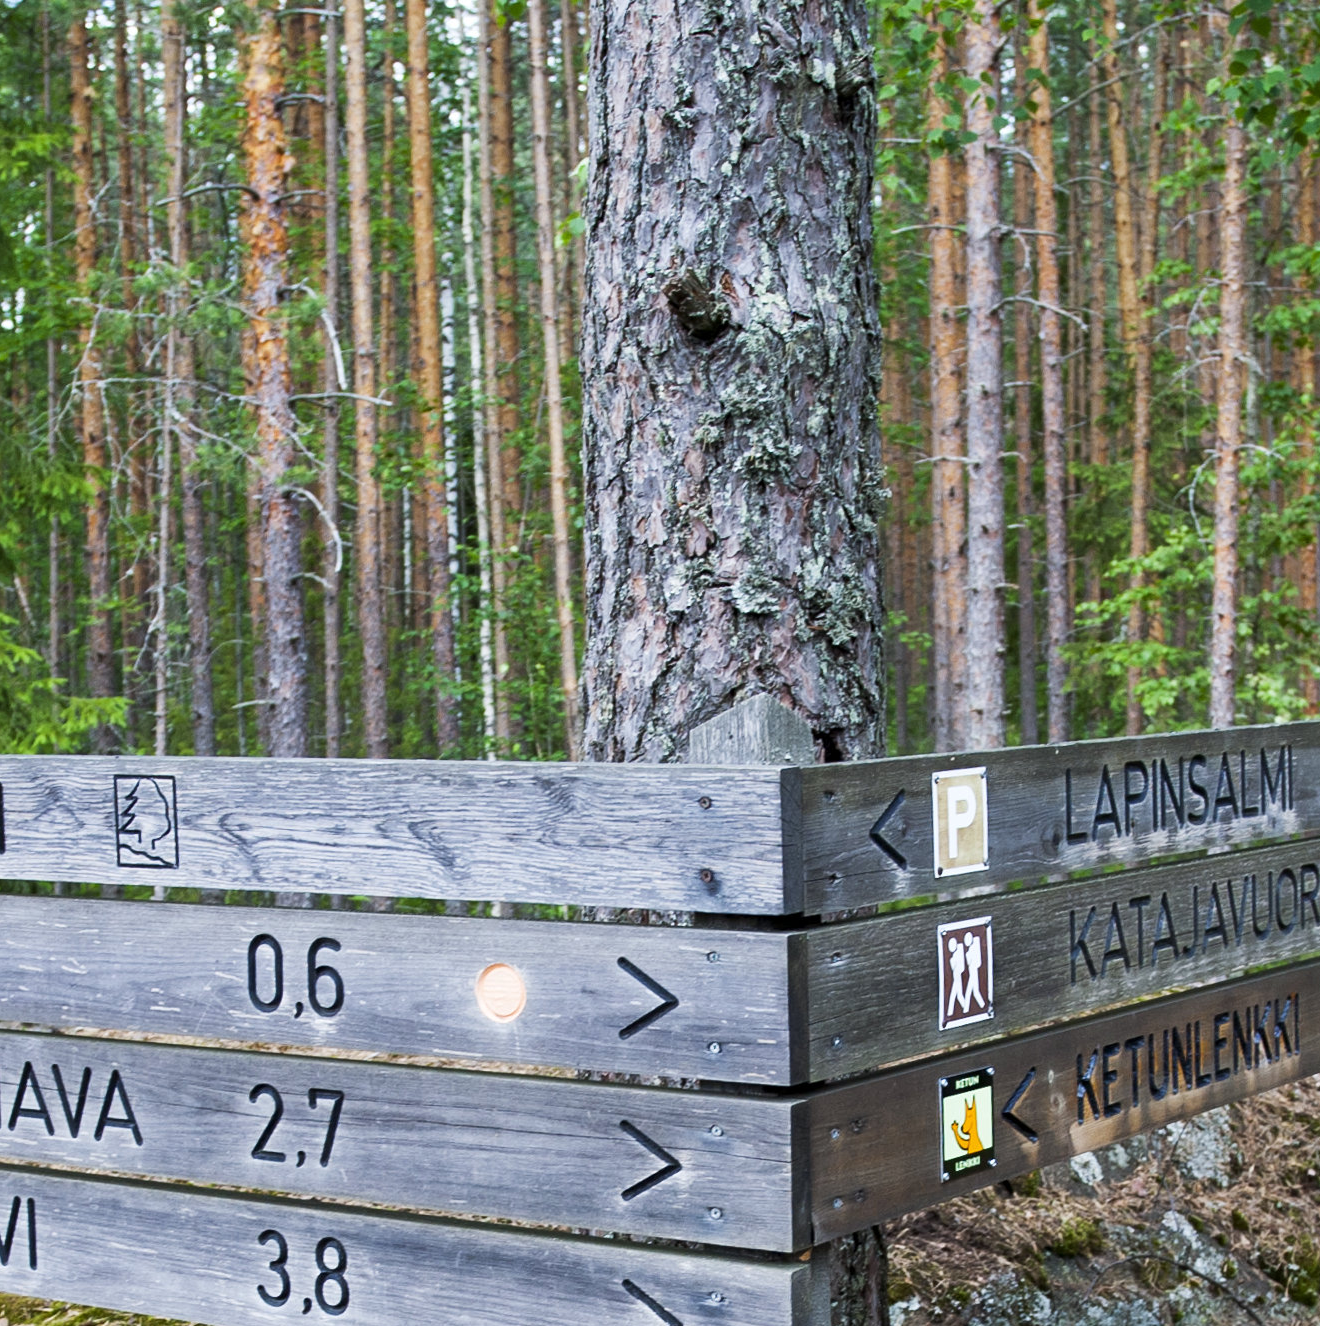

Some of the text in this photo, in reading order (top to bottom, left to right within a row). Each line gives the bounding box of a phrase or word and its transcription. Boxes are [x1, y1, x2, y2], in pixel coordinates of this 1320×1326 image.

[948, 783, 977, 860] P
[1065, 745, 1295, 845] LAPINSALMI
[247, 934, 345, 1019] 0,6
[1076, 993, 1300, 1124] KETUNLENKKI
[249, 1083, 345, 1168] 2,7
[257, 1229, 350, 1316] 3,8
